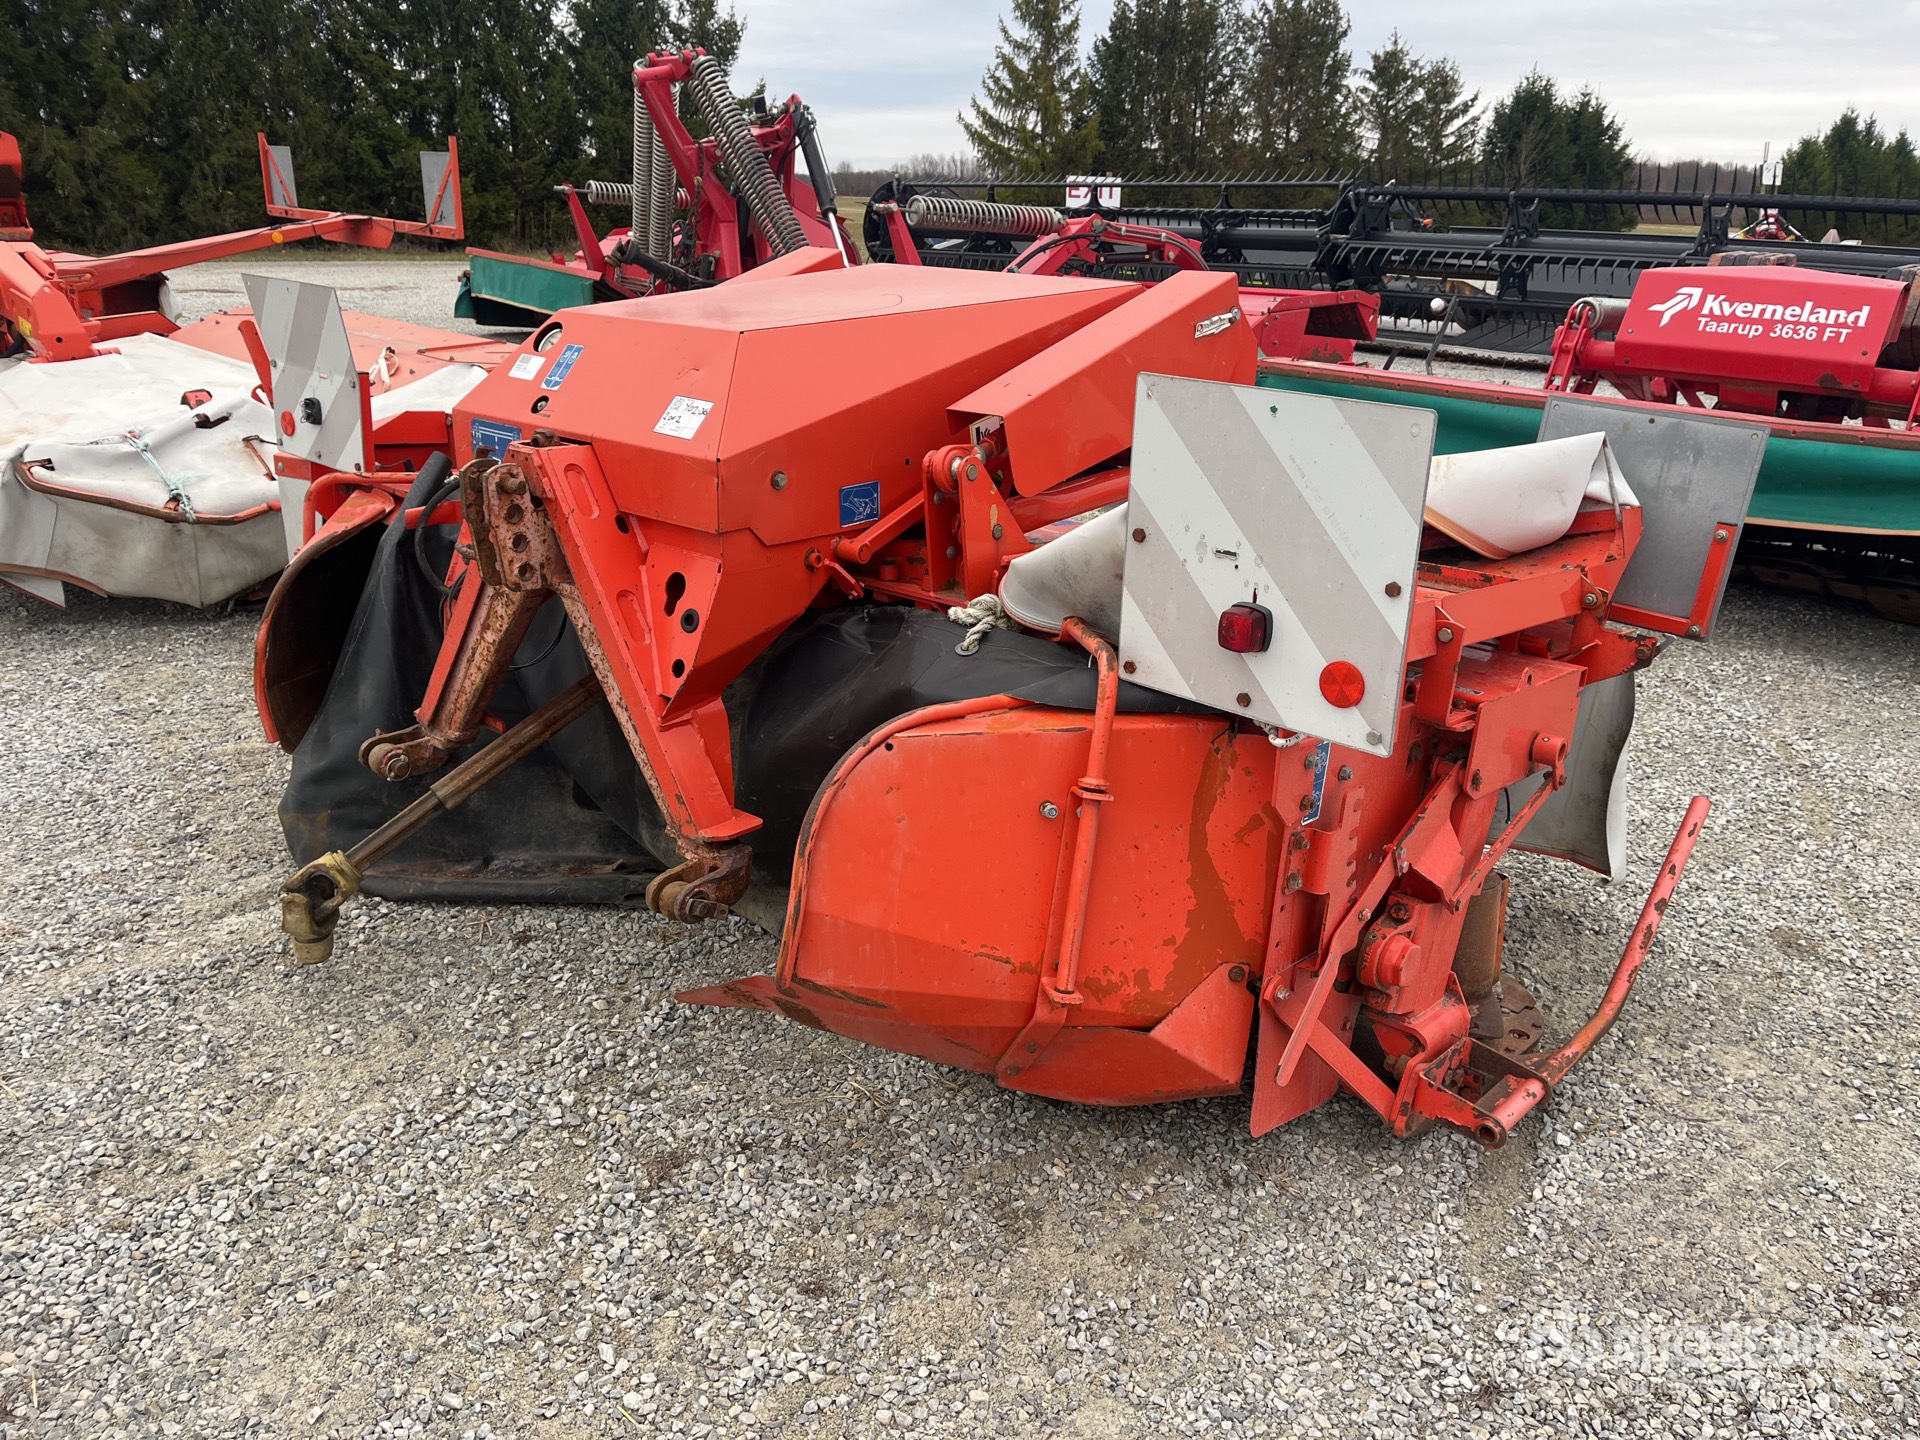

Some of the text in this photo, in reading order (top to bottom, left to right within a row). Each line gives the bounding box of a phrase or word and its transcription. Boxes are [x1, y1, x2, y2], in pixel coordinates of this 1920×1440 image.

[1701, 294, 1870, 327] Kverneland
[1698, 317, 1852, 343] Taarup 3636 FT
